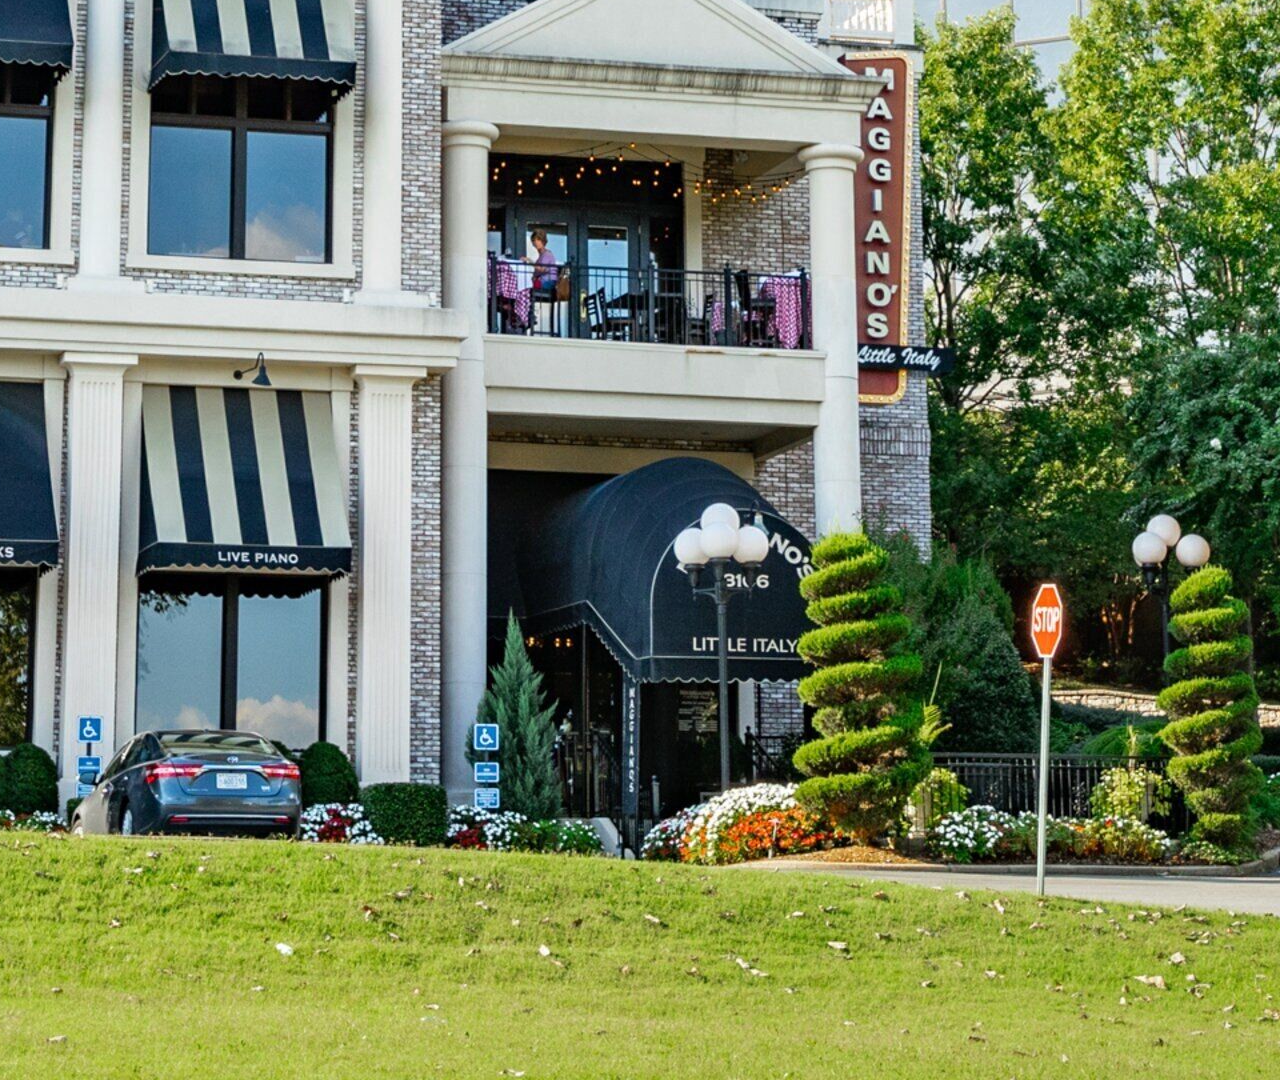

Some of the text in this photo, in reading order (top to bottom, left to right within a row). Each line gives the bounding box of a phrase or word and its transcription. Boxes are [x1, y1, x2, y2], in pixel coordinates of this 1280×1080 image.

[864, 67, 898, 339] MAGGIANO'S
[857, 345, 941, 371] Little Italy
[217, 551, 299, 564] LIVE PIANO
[1034, 606, 1060, 632] STOP
[693, 637, 798, 653] LITLE ITALY
